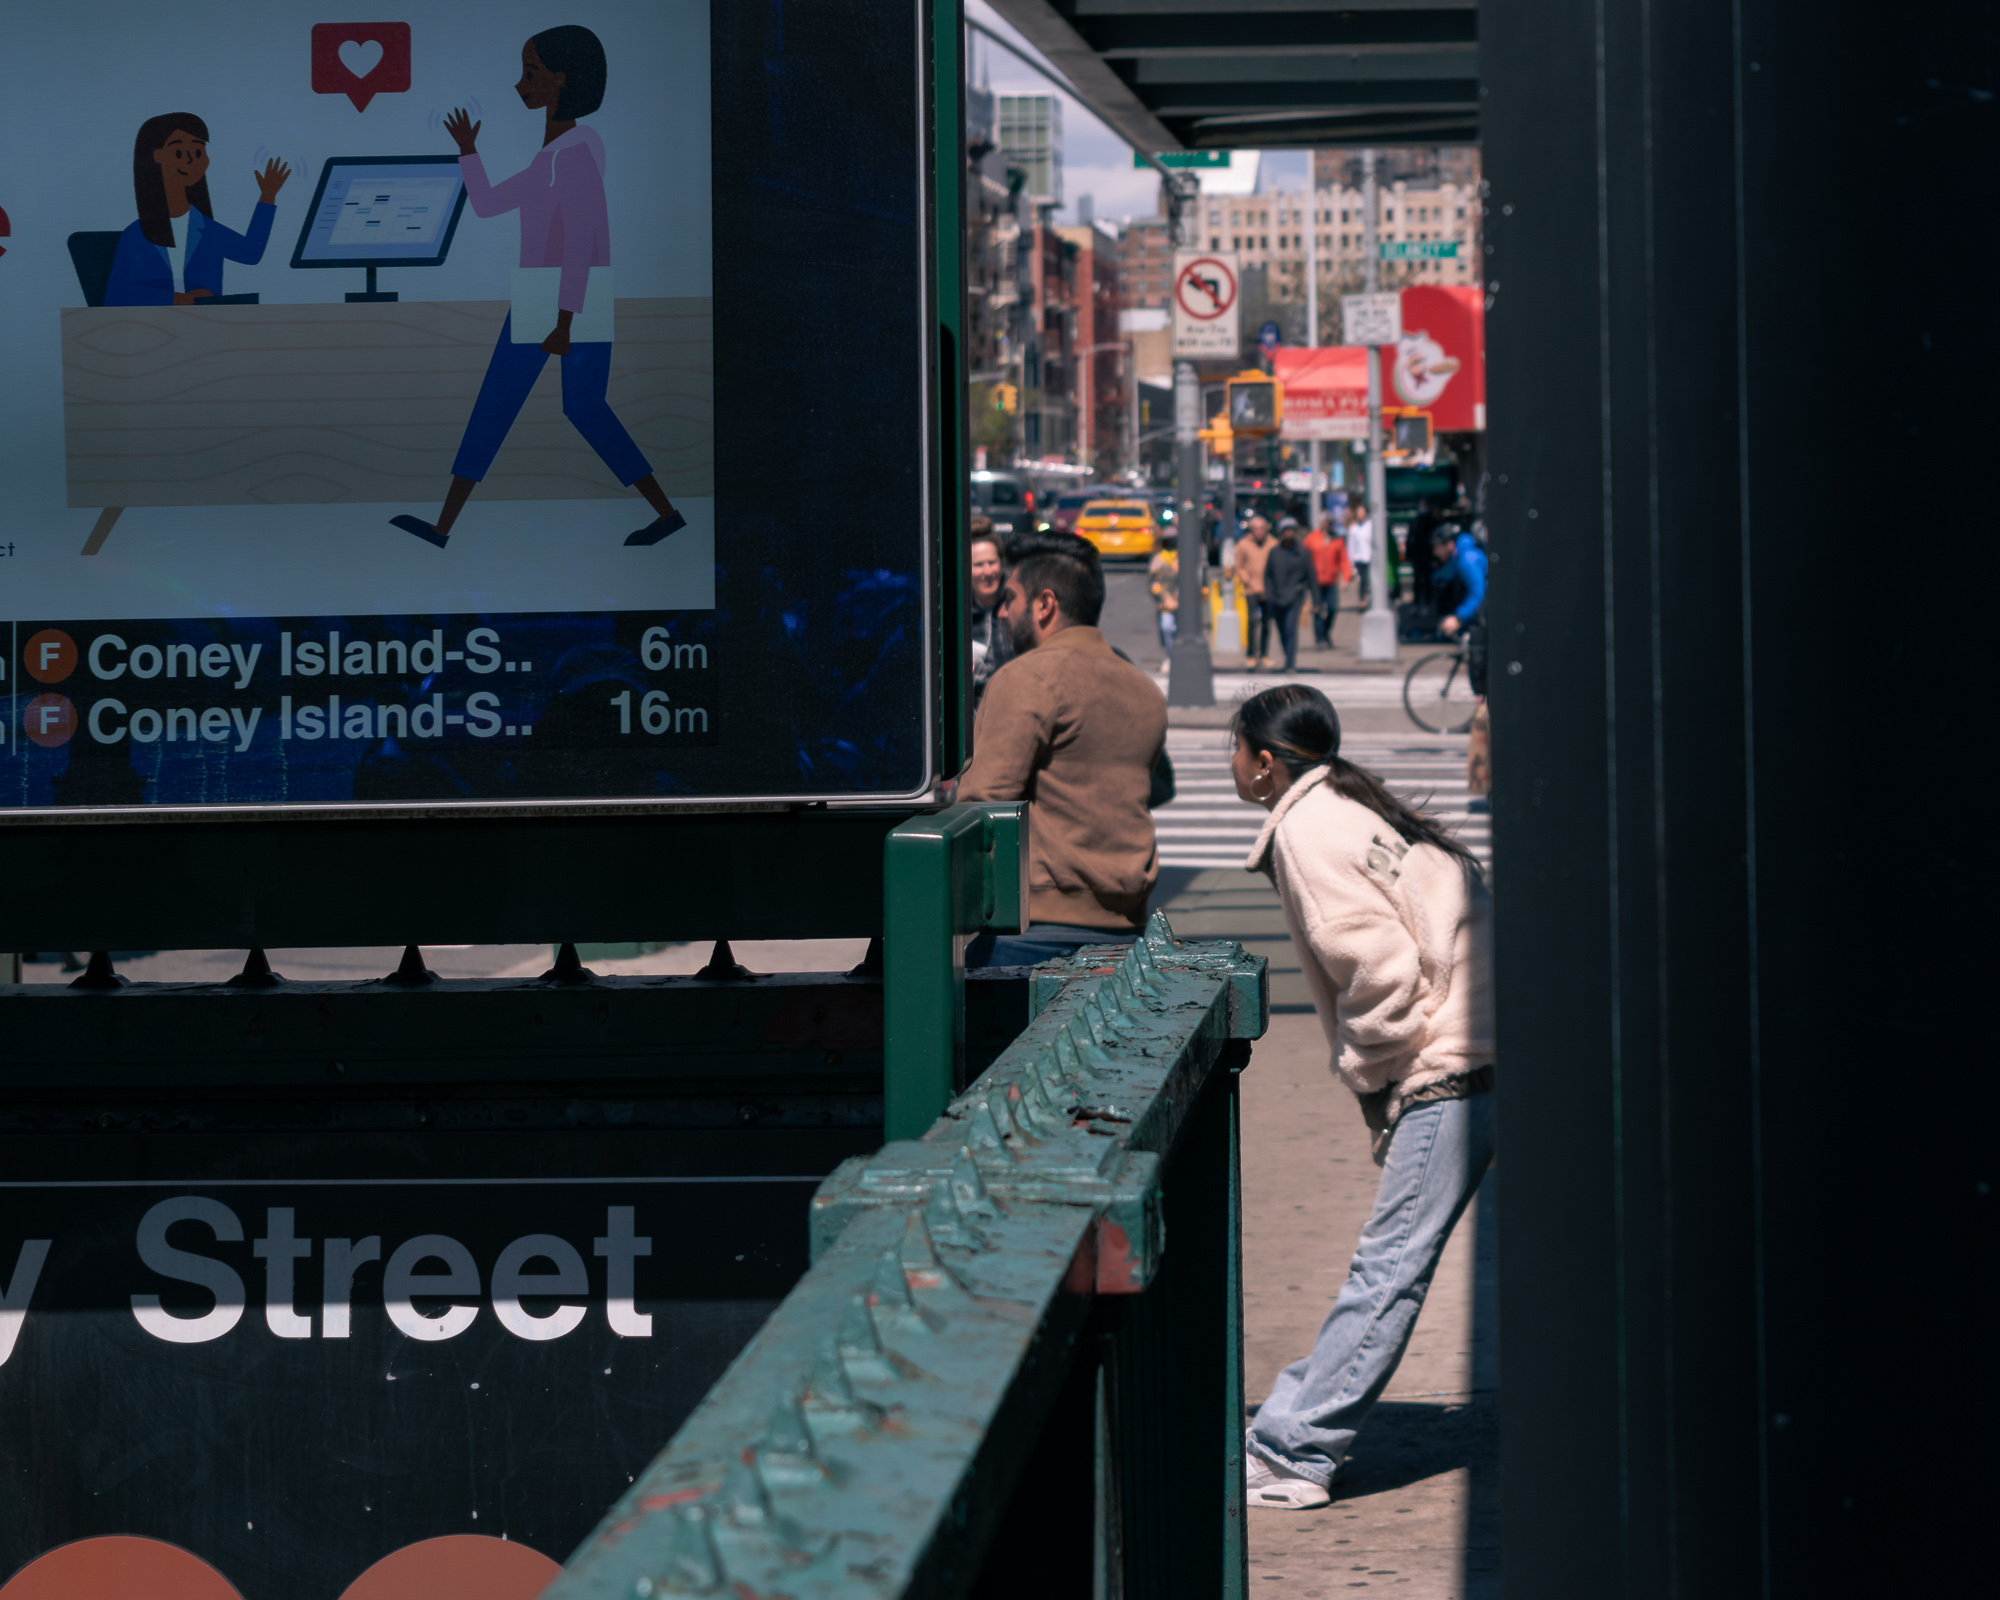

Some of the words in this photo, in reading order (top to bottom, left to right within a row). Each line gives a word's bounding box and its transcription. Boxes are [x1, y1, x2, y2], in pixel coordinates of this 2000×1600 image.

[41, 643, 61, 669] F
[89, 634, 263, 690] Coney
[281, 627, 532, 677] Island-S..
[642, 626, 708, 672] 6m
[41, 707, 61, 734] F
[89, 698, 263, 753] Coney
[281, 691, 532, 740] Island-S..
[611, 690, 708, 735] 16m
[131, 1196, 653, 1344] Street
